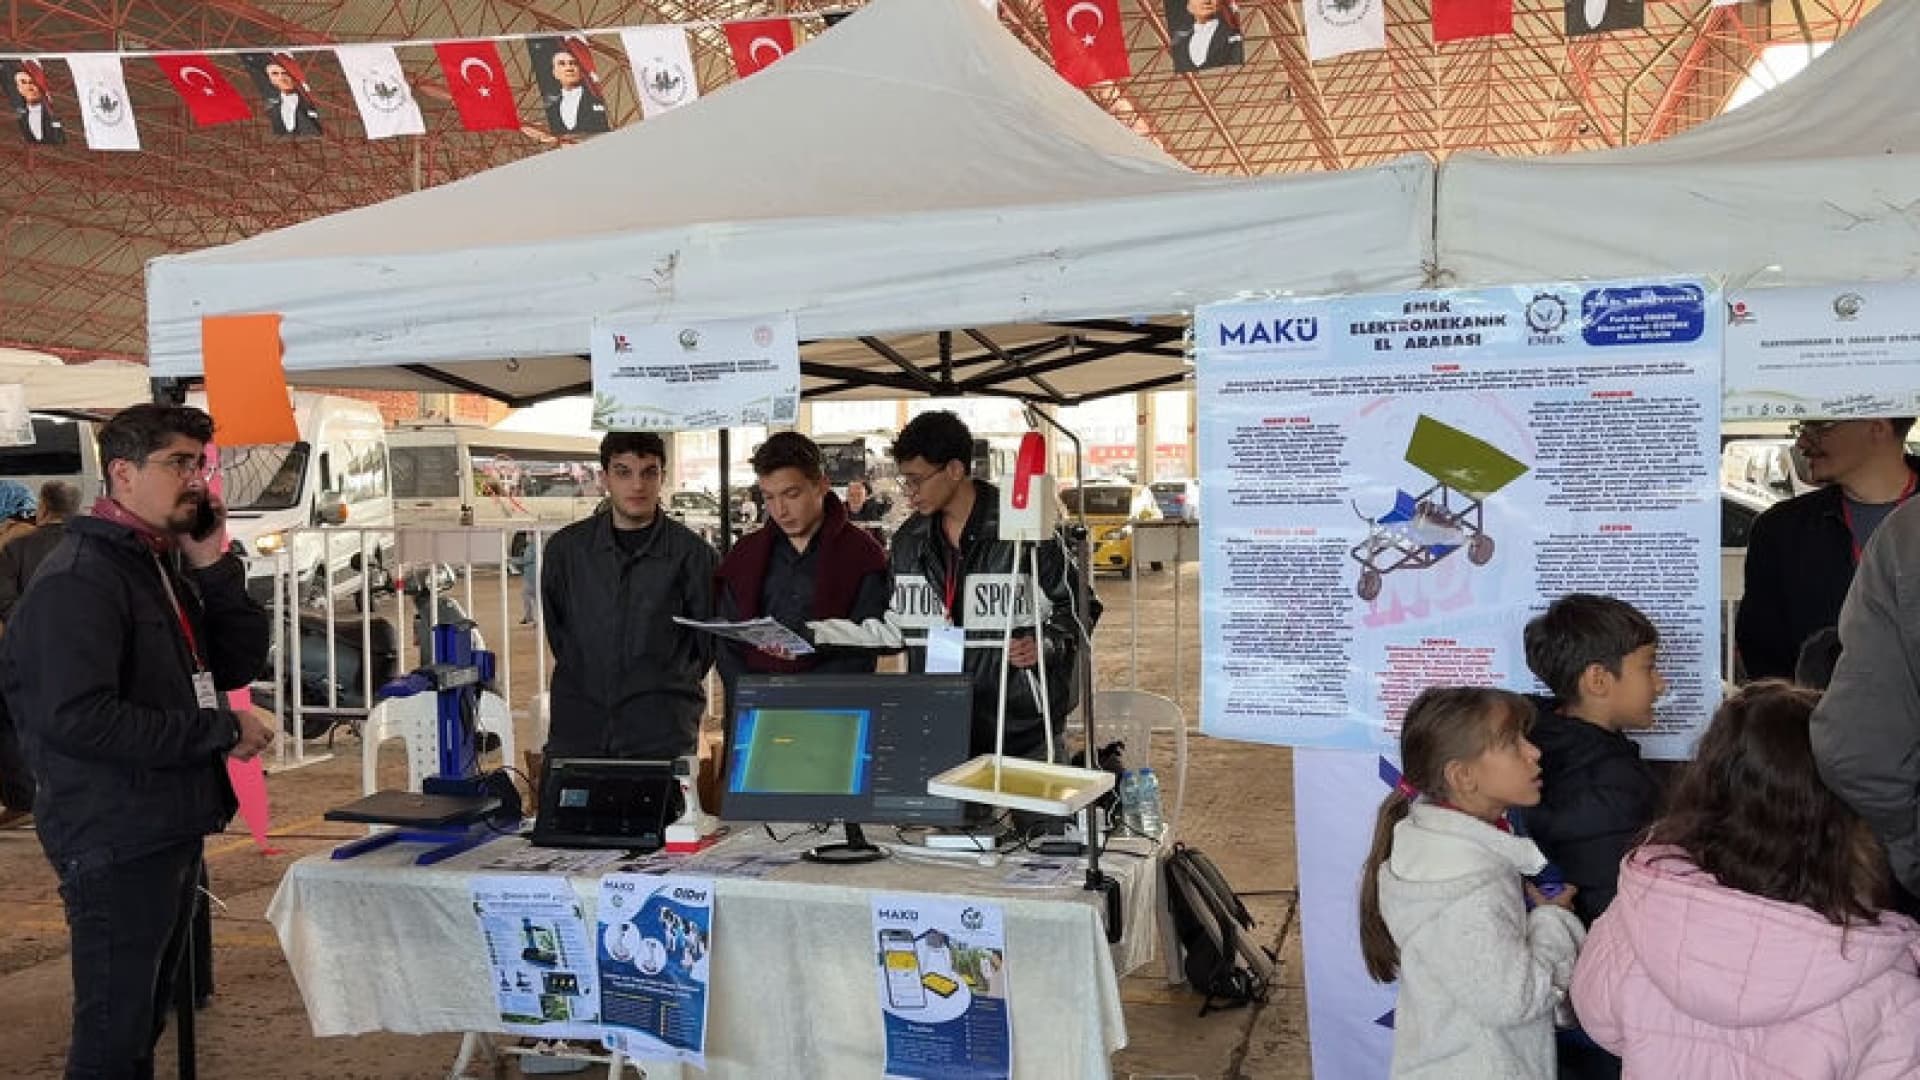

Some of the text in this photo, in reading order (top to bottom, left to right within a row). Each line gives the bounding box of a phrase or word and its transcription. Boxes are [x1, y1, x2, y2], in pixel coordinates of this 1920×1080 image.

[1403, 300, 1450, 315] EMEK
[1220, 317, 1317, 346] MAKÜ
[1528, 334, 1565, 346] EMEK
[1374, 333, 1481, 351] EL ARABASI
[894, 583, 945, 616] OTOR
